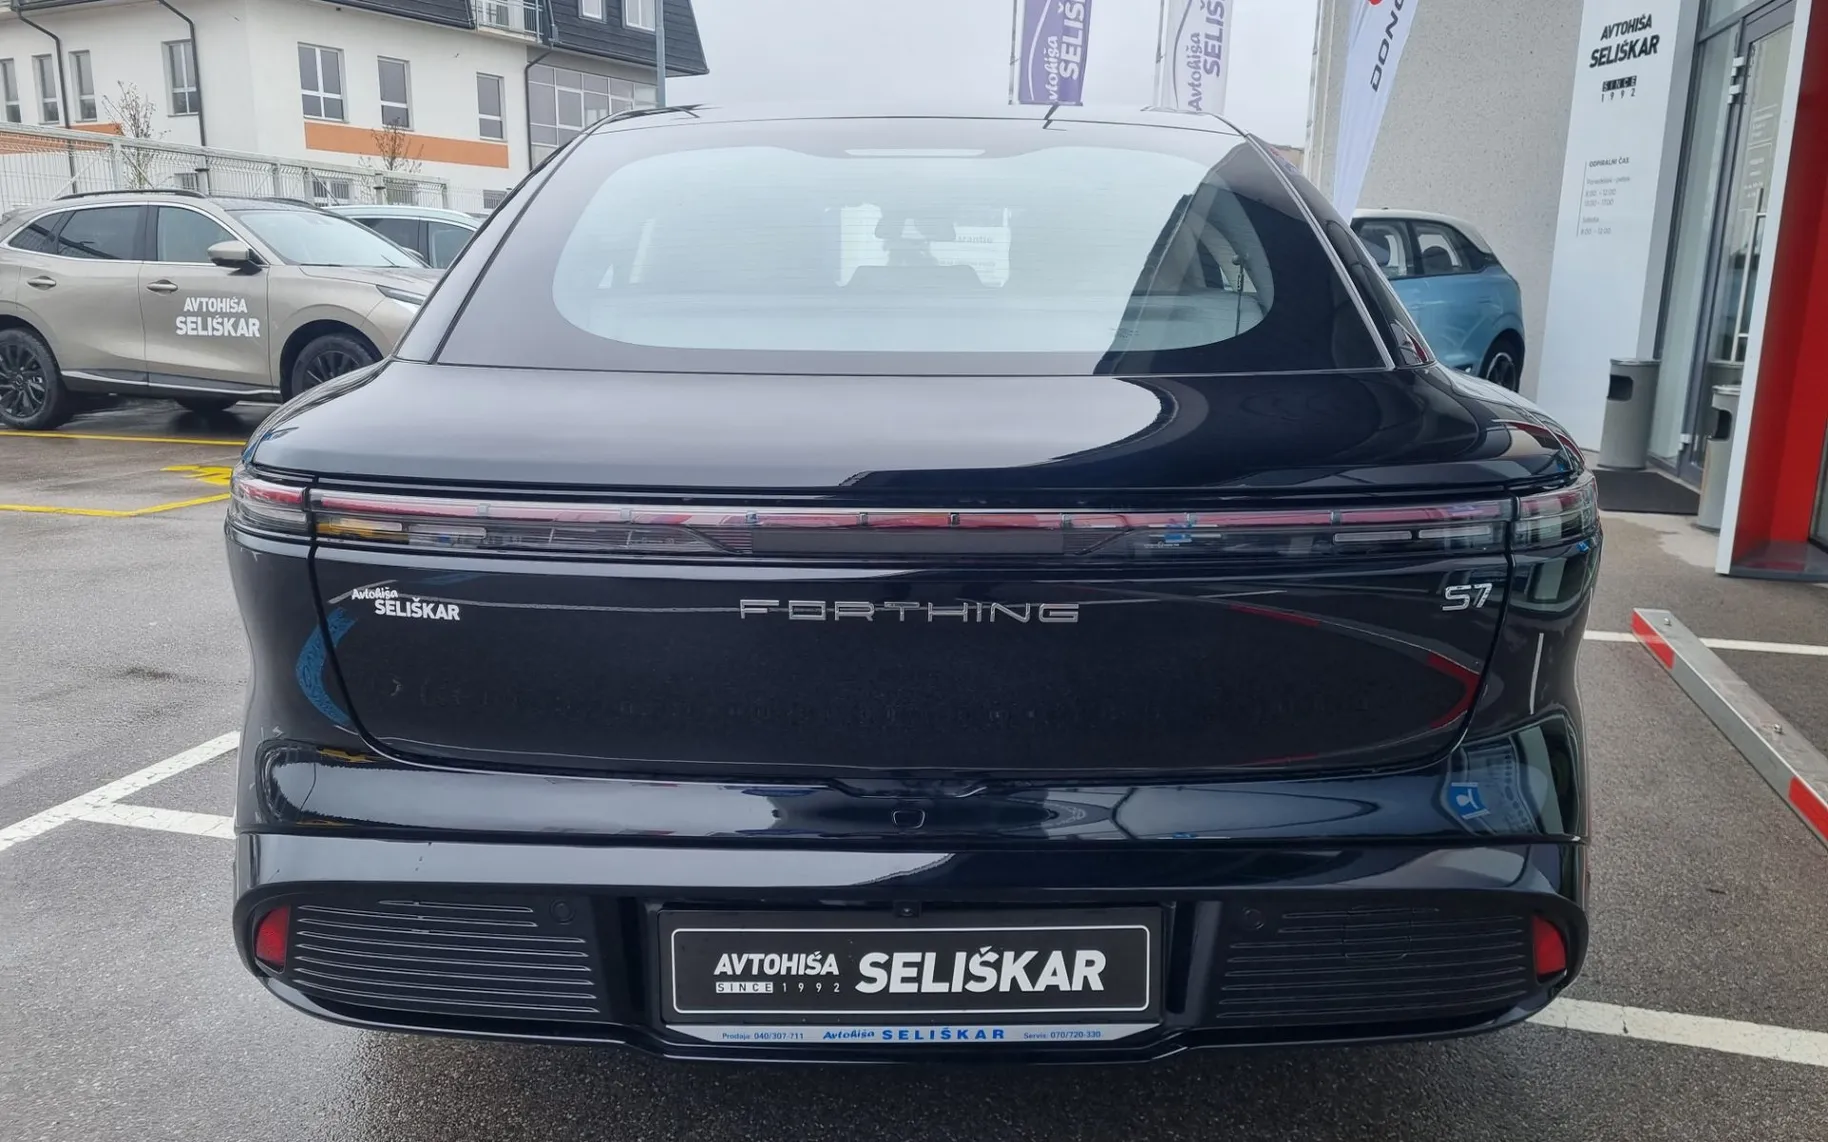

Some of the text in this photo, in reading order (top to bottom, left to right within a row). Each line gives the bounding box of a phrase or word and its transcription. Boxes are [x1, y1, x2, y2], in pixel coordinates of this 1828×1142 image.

[1057, 0, 1085, 80] SELIŠ
[1200, 0, 1225, 77] SELIŠ
[1044, 36, 1059, 102] vtohiša
[1601, 88, 1635, 103] 1992
[1602, 76, 1637, 92] SINCE
[1442, 582, 1492, 611] S7
[374, 597, 460, 621] SELIŠKAR
[740, 599, 1079, 623] FORTHING
[716, 982, 840, 993] SINCE 1992
[882, 1027, 1005, 1040] SELIŠKAR
